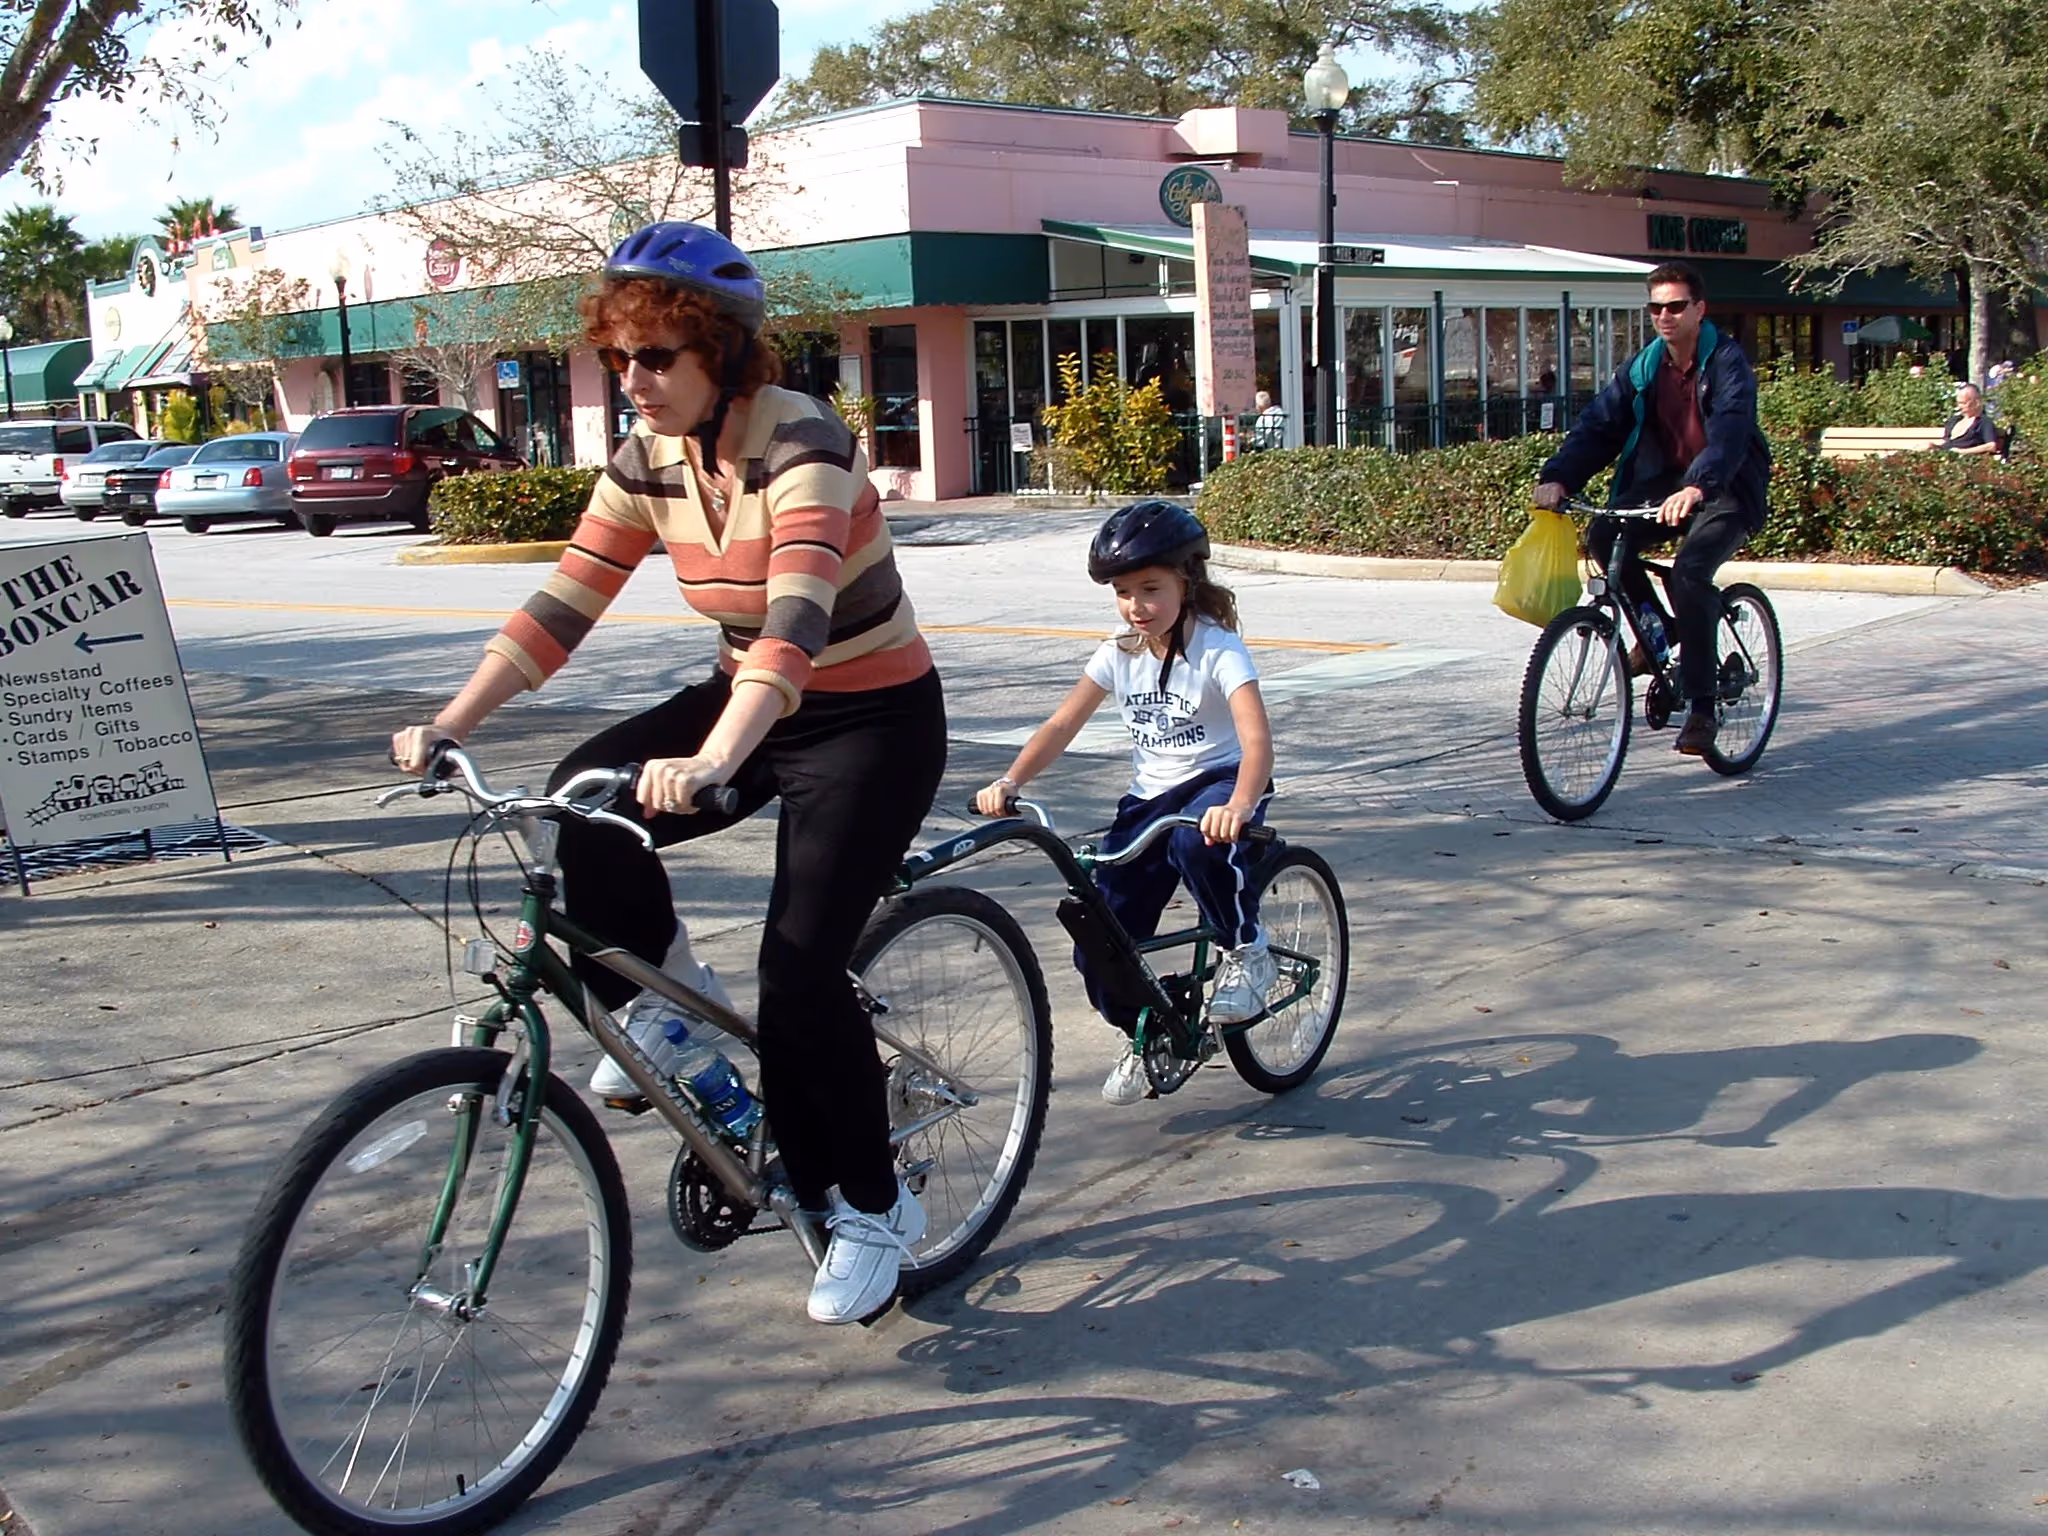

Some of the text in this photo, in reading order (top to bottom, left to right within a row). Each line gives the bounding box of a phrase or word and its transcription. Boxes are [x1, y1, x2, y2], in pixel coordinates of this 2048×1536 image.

[0, 554, 83, 610] THE
[0, 570, 143, 657] BOXCAR
[0, 662, 103, 688] Newsstand
[3, 674, 174, 709] Specialty Coffees
[8, 701, 134, 727] Sundry Items
[13, 728, 69, 747] Cards
[94, 719, 141, 738] Gifts
[18, 746, 91, 767] Stamps
[113, 730, 194, 754] Tobacco
[1126, 724, 1205, 748] HAMPIONS
